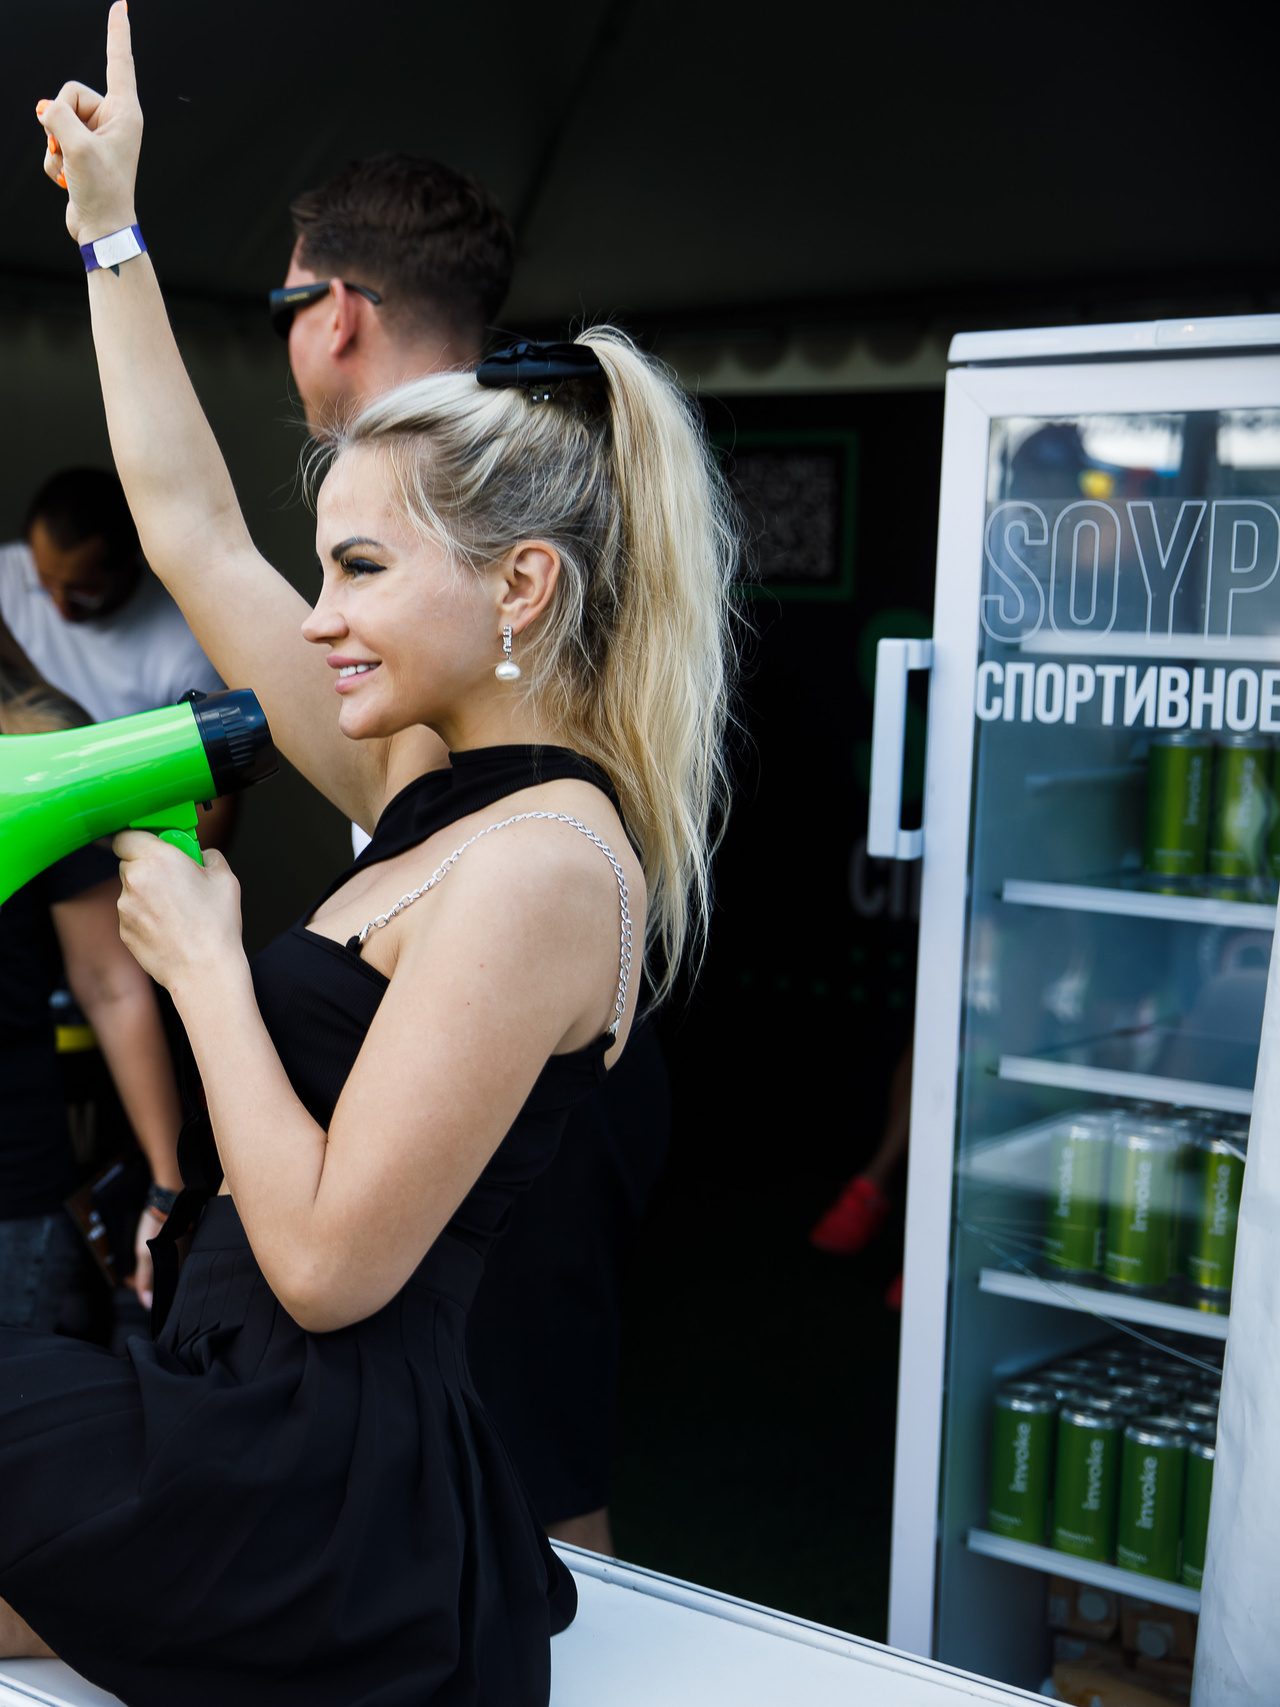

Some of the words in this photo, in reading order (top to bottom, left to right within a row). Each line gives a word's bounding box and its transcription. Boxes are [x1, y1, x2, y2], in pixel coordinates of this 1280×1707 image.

[981, 500, 1280, 644] SOYP
[975, 660, 1280, 732] СПОРТИВНОЕ
[1129, 1160, 1152, 1233] invoke
[1209, 1163, 1231, 1236] invoke
[1009, 1421, 1031, 1493] invoke
[1082, 1438, 1104, 1511] invoke
[1135, 1455, 1158, 1529] invoke
